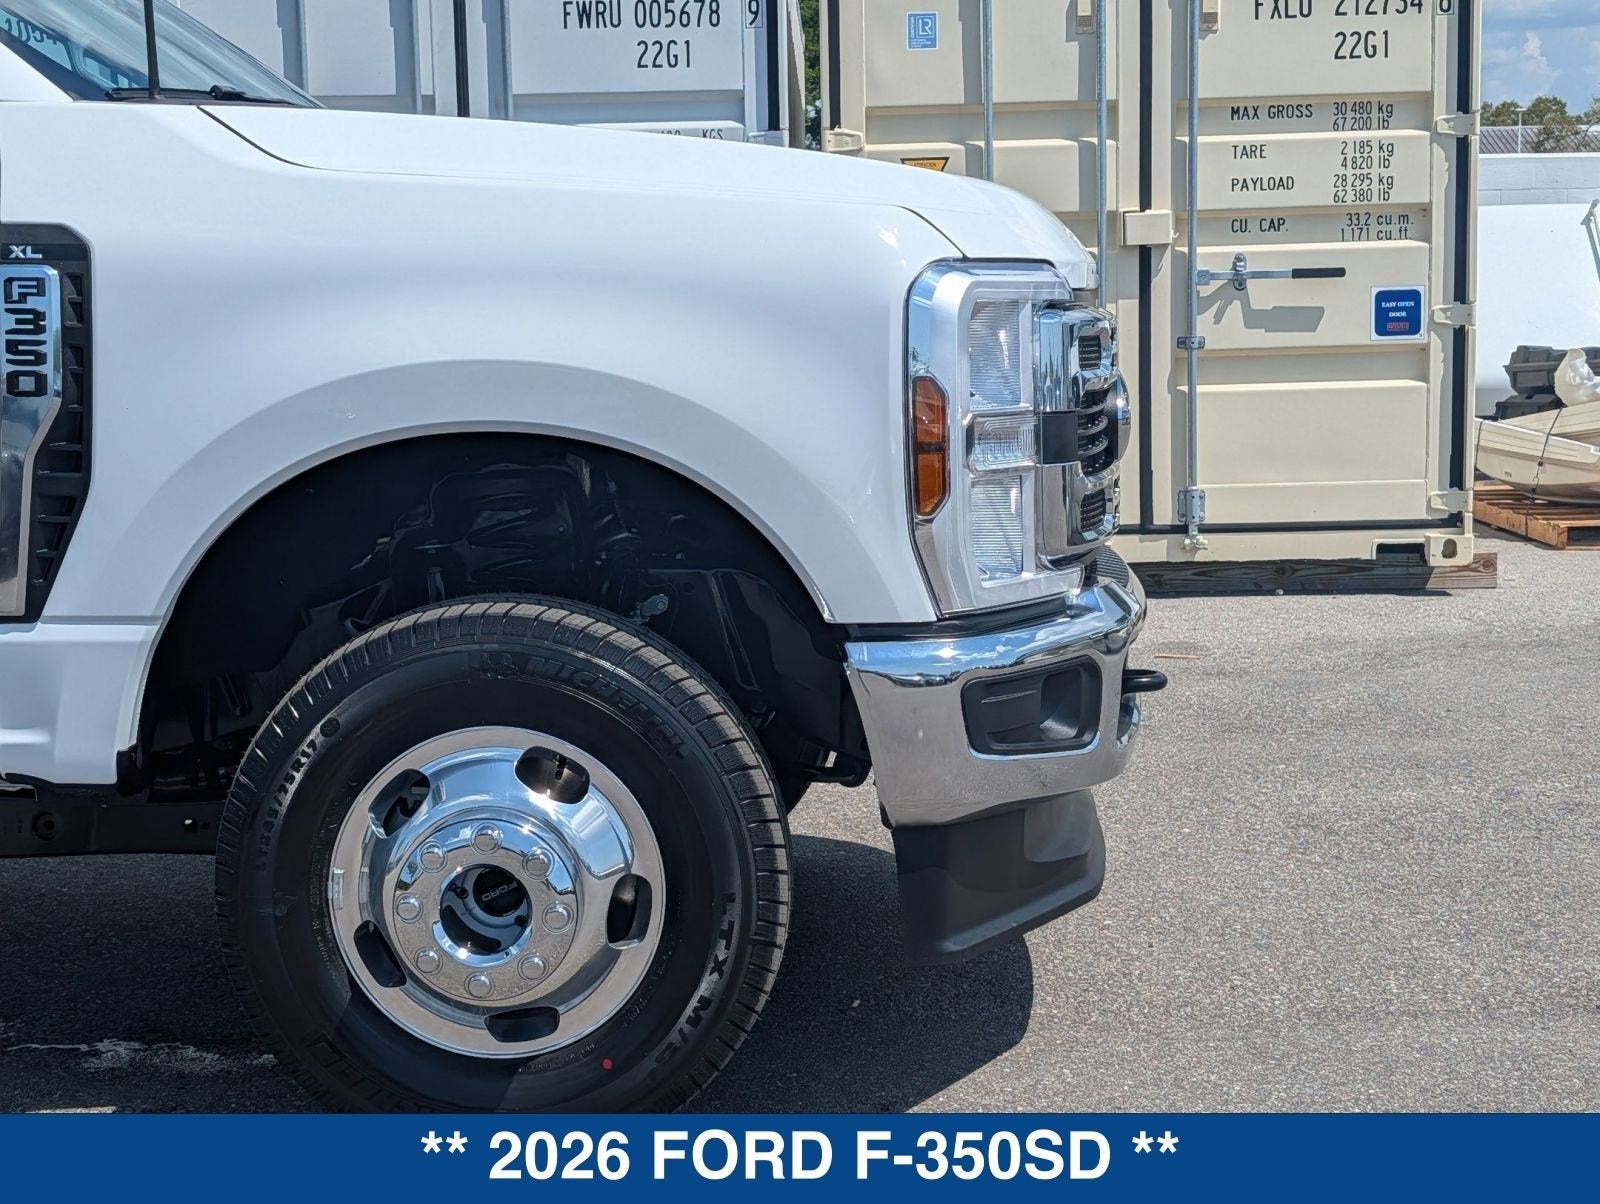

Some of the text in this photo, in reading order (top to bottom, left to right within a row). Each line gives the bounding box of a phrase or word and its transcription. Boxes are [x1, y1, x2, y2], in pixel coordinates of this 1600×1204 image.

[562, 0, 622, 29] FWRU
[634, 0, 721, 28] 005678
[1333, 30, 1389, 60] 22G1
[636, 40, 691, 69] 22G1
[1230, 104, 1314, 121] MAX GROSS
[1377, 100, 1394, 119] kg
[1377, 115, 1390, 130] lb
[1231, 144, 1268, 160] TARE
[1378, 139, 1394, 158] kg
[1378, 155, 1391, 169] lb
[1231, 176, 1295, 192] PAYLOAD
[1378, 172, 1394, 190] kg
[1378, 187, 1391, 202] lb
[1230, 217, 1289, 233] CU. CAP.
[1345, 211, 1372, 227] 33.2
[8, 245, 43, 259] XL
